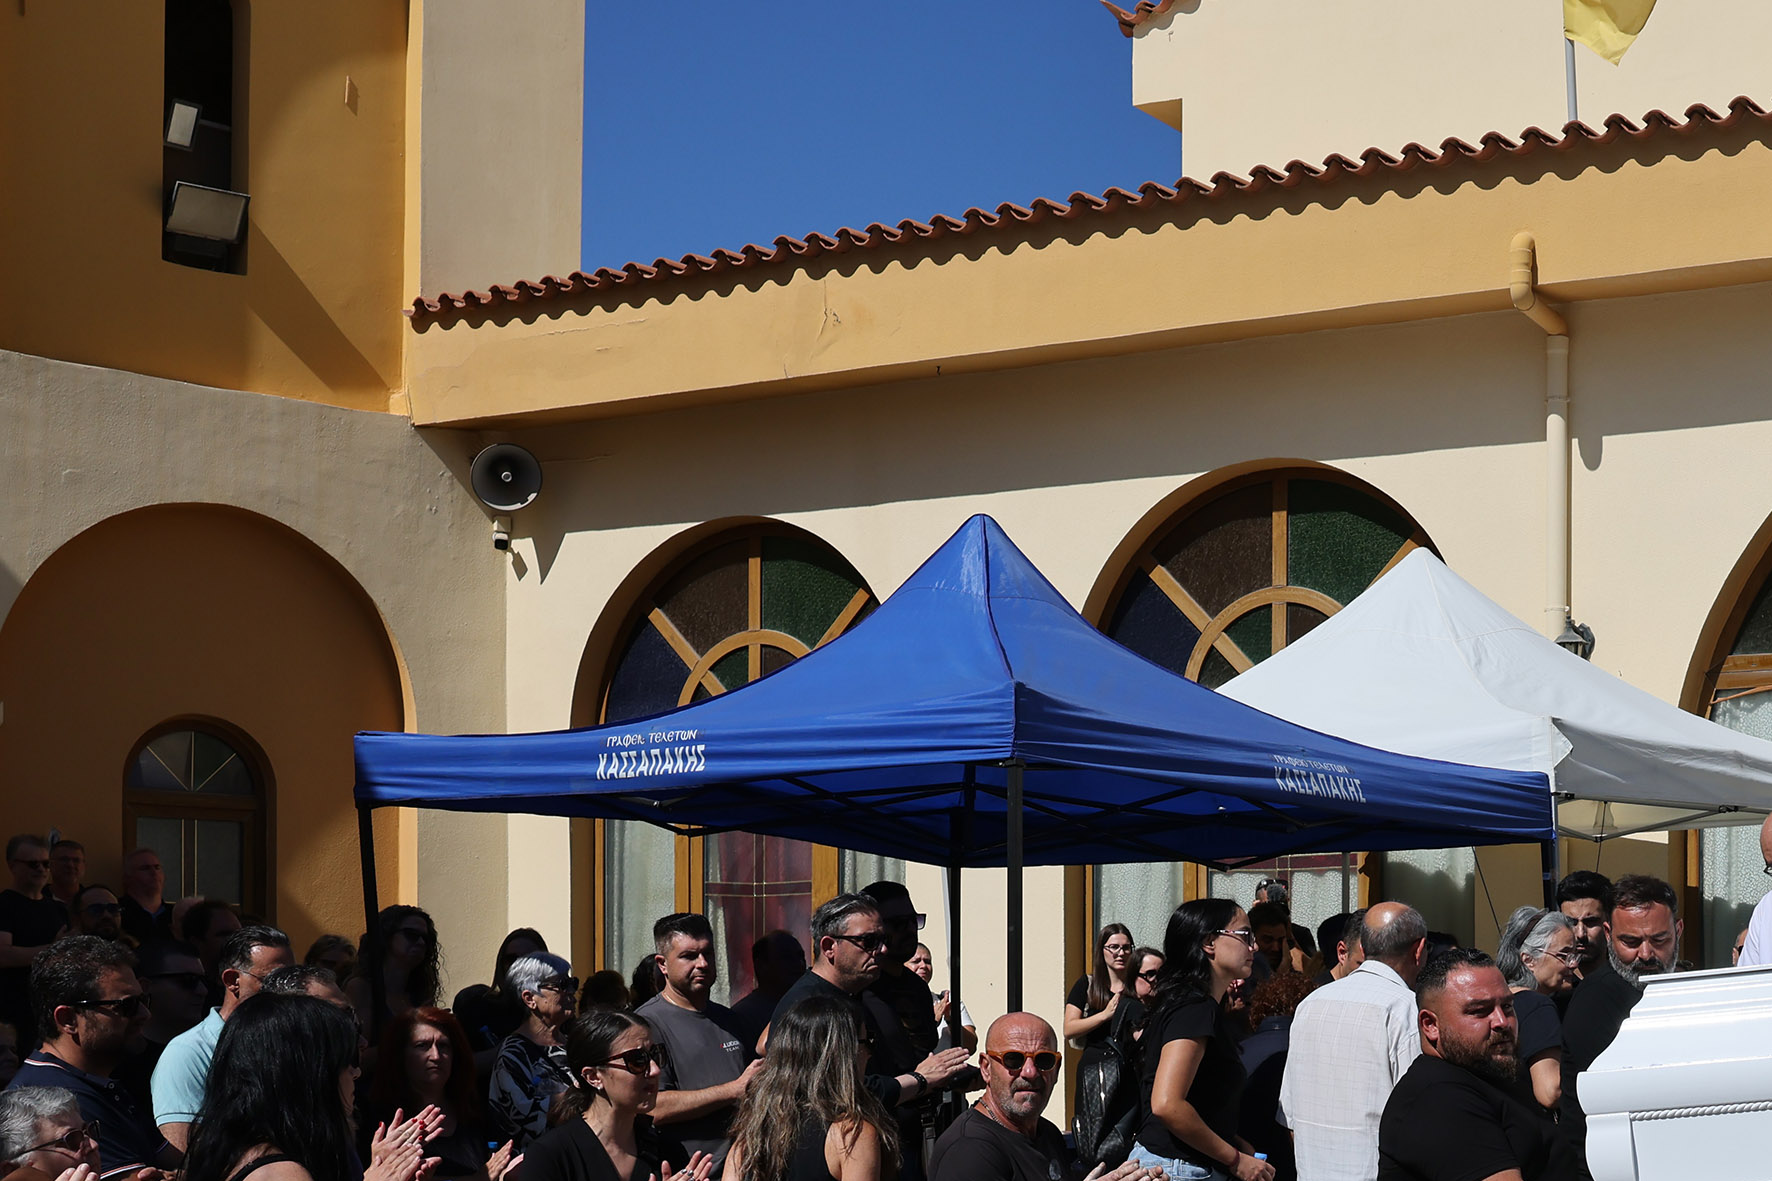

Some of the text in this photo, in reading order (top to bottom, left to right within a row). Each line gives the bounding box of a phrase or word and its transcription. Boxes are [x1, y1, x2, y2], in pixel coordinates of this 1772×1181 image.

[649, 729, 698, 743] ΤΕΛΕΤΩΝ
[596, 744, 706, 780] ΚΑΣΣΑΠΑΚΗΣ
[1274, 765, 1366, 803] ΚΑΣΣΑΠΑΚΗΣ
